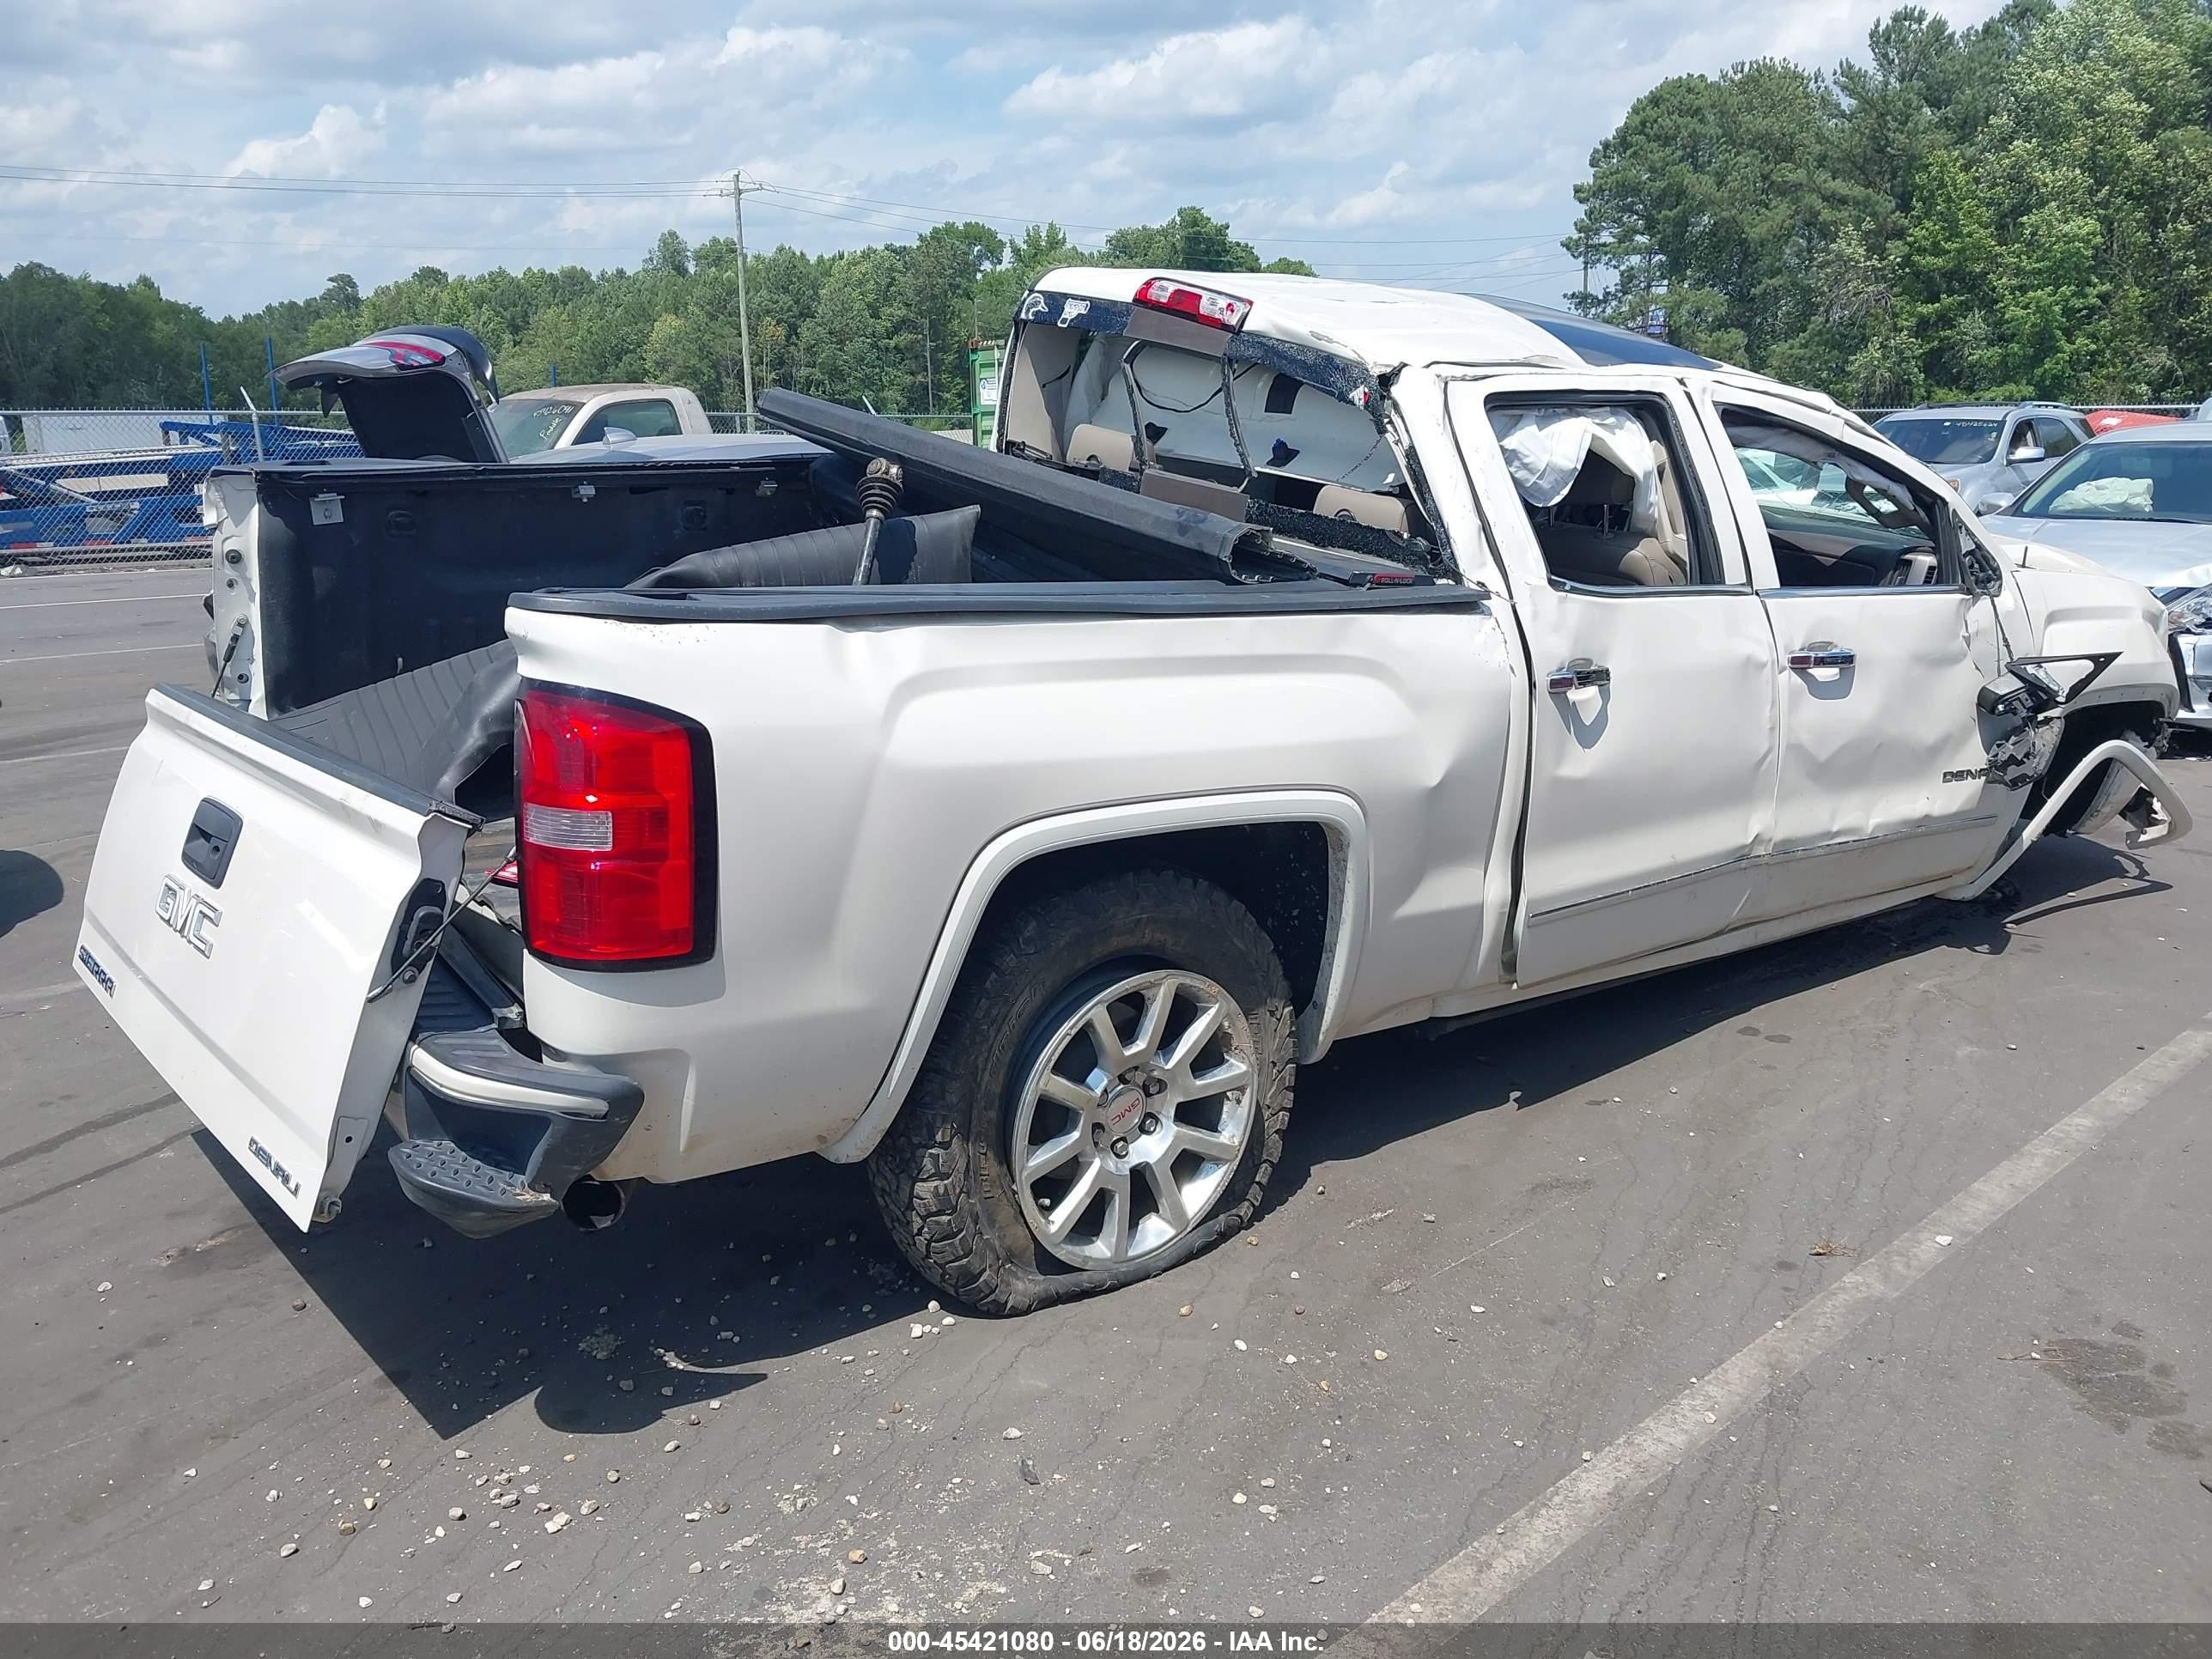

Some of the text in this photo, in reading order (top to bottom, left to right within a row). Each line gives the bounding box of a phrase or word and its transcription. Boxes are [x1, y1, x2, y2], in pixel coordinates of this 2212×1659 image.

[155, 873, 223, 960] GMC
[78, 945, 117, 999] SIERRA
[1111, 1097, 1140, 1126] GMC
[248, 1136, 302, 1200] DENALI
